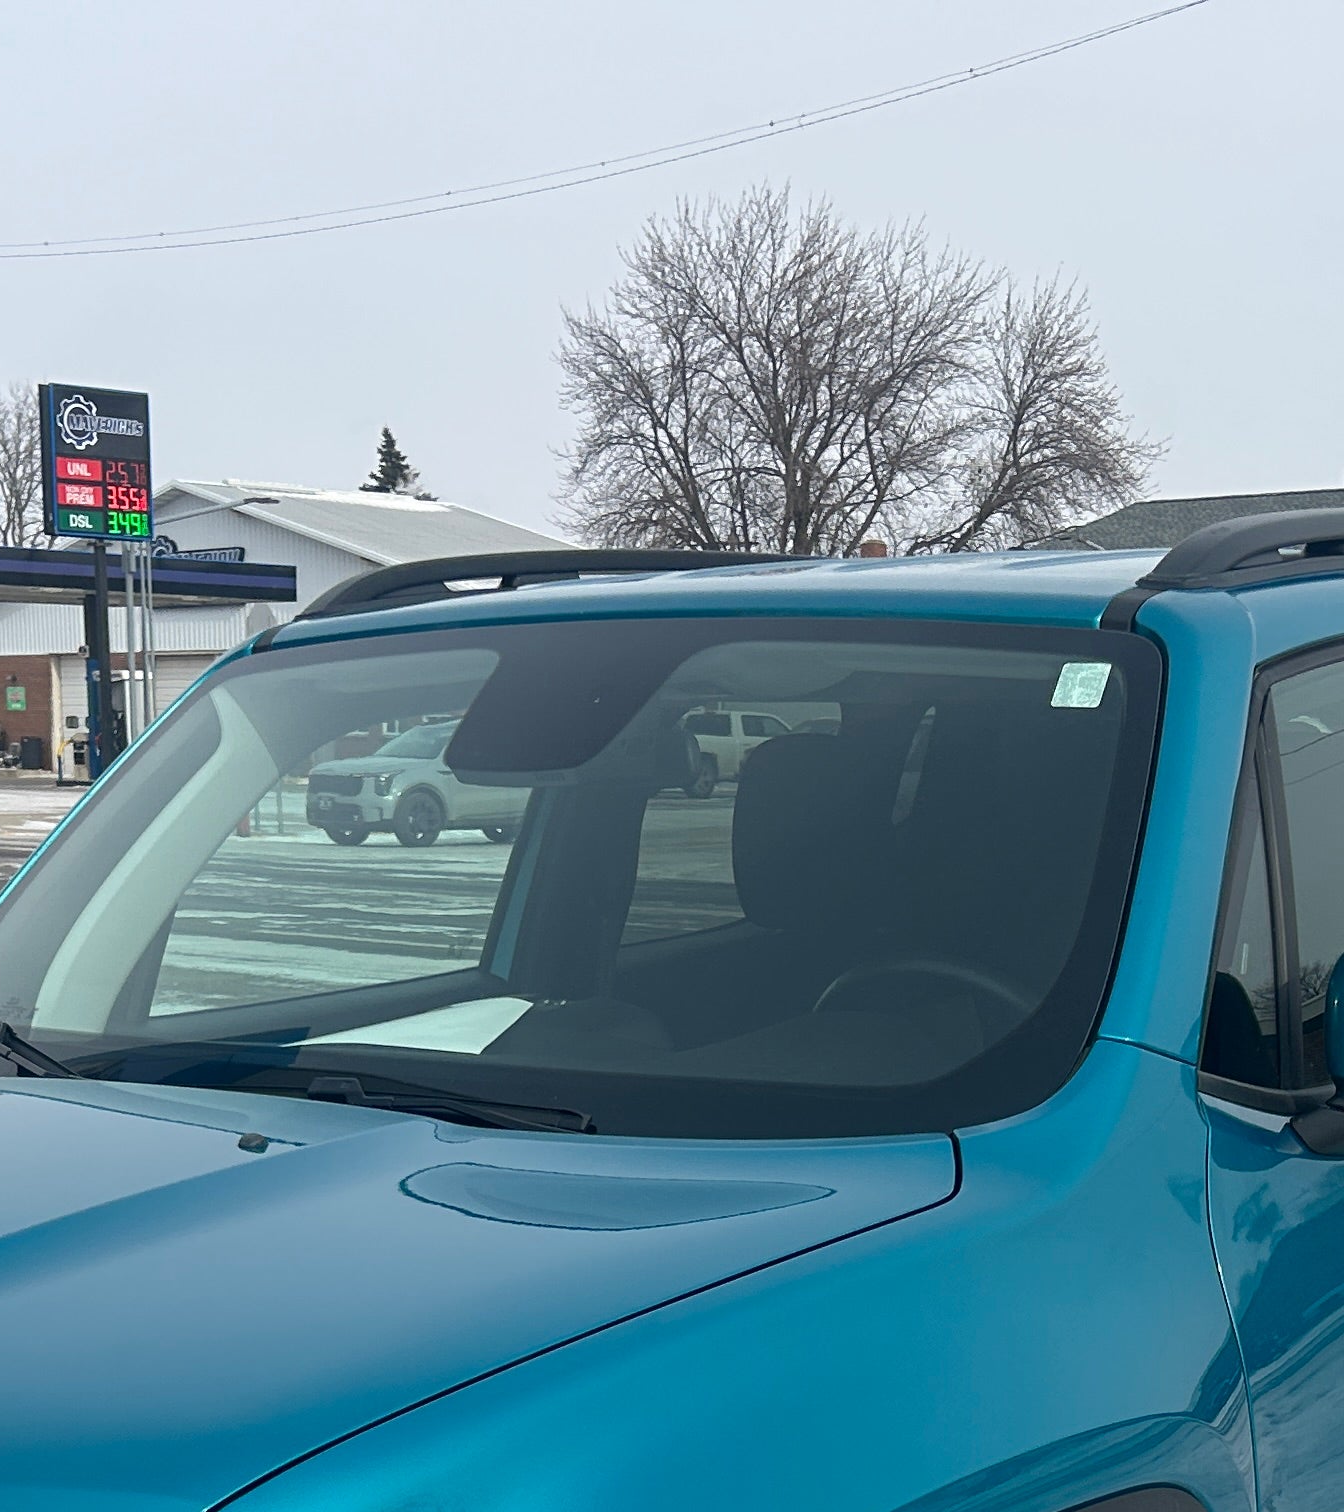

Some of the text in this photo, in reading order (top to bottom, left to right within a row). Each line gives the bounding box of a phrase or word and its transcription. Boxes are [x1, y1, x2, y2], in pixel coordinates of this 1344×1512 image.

[67, 461, 92, 477] UNL
[66, 493, 95, 505] PREM
[69, 513, 93, 528] DSL
